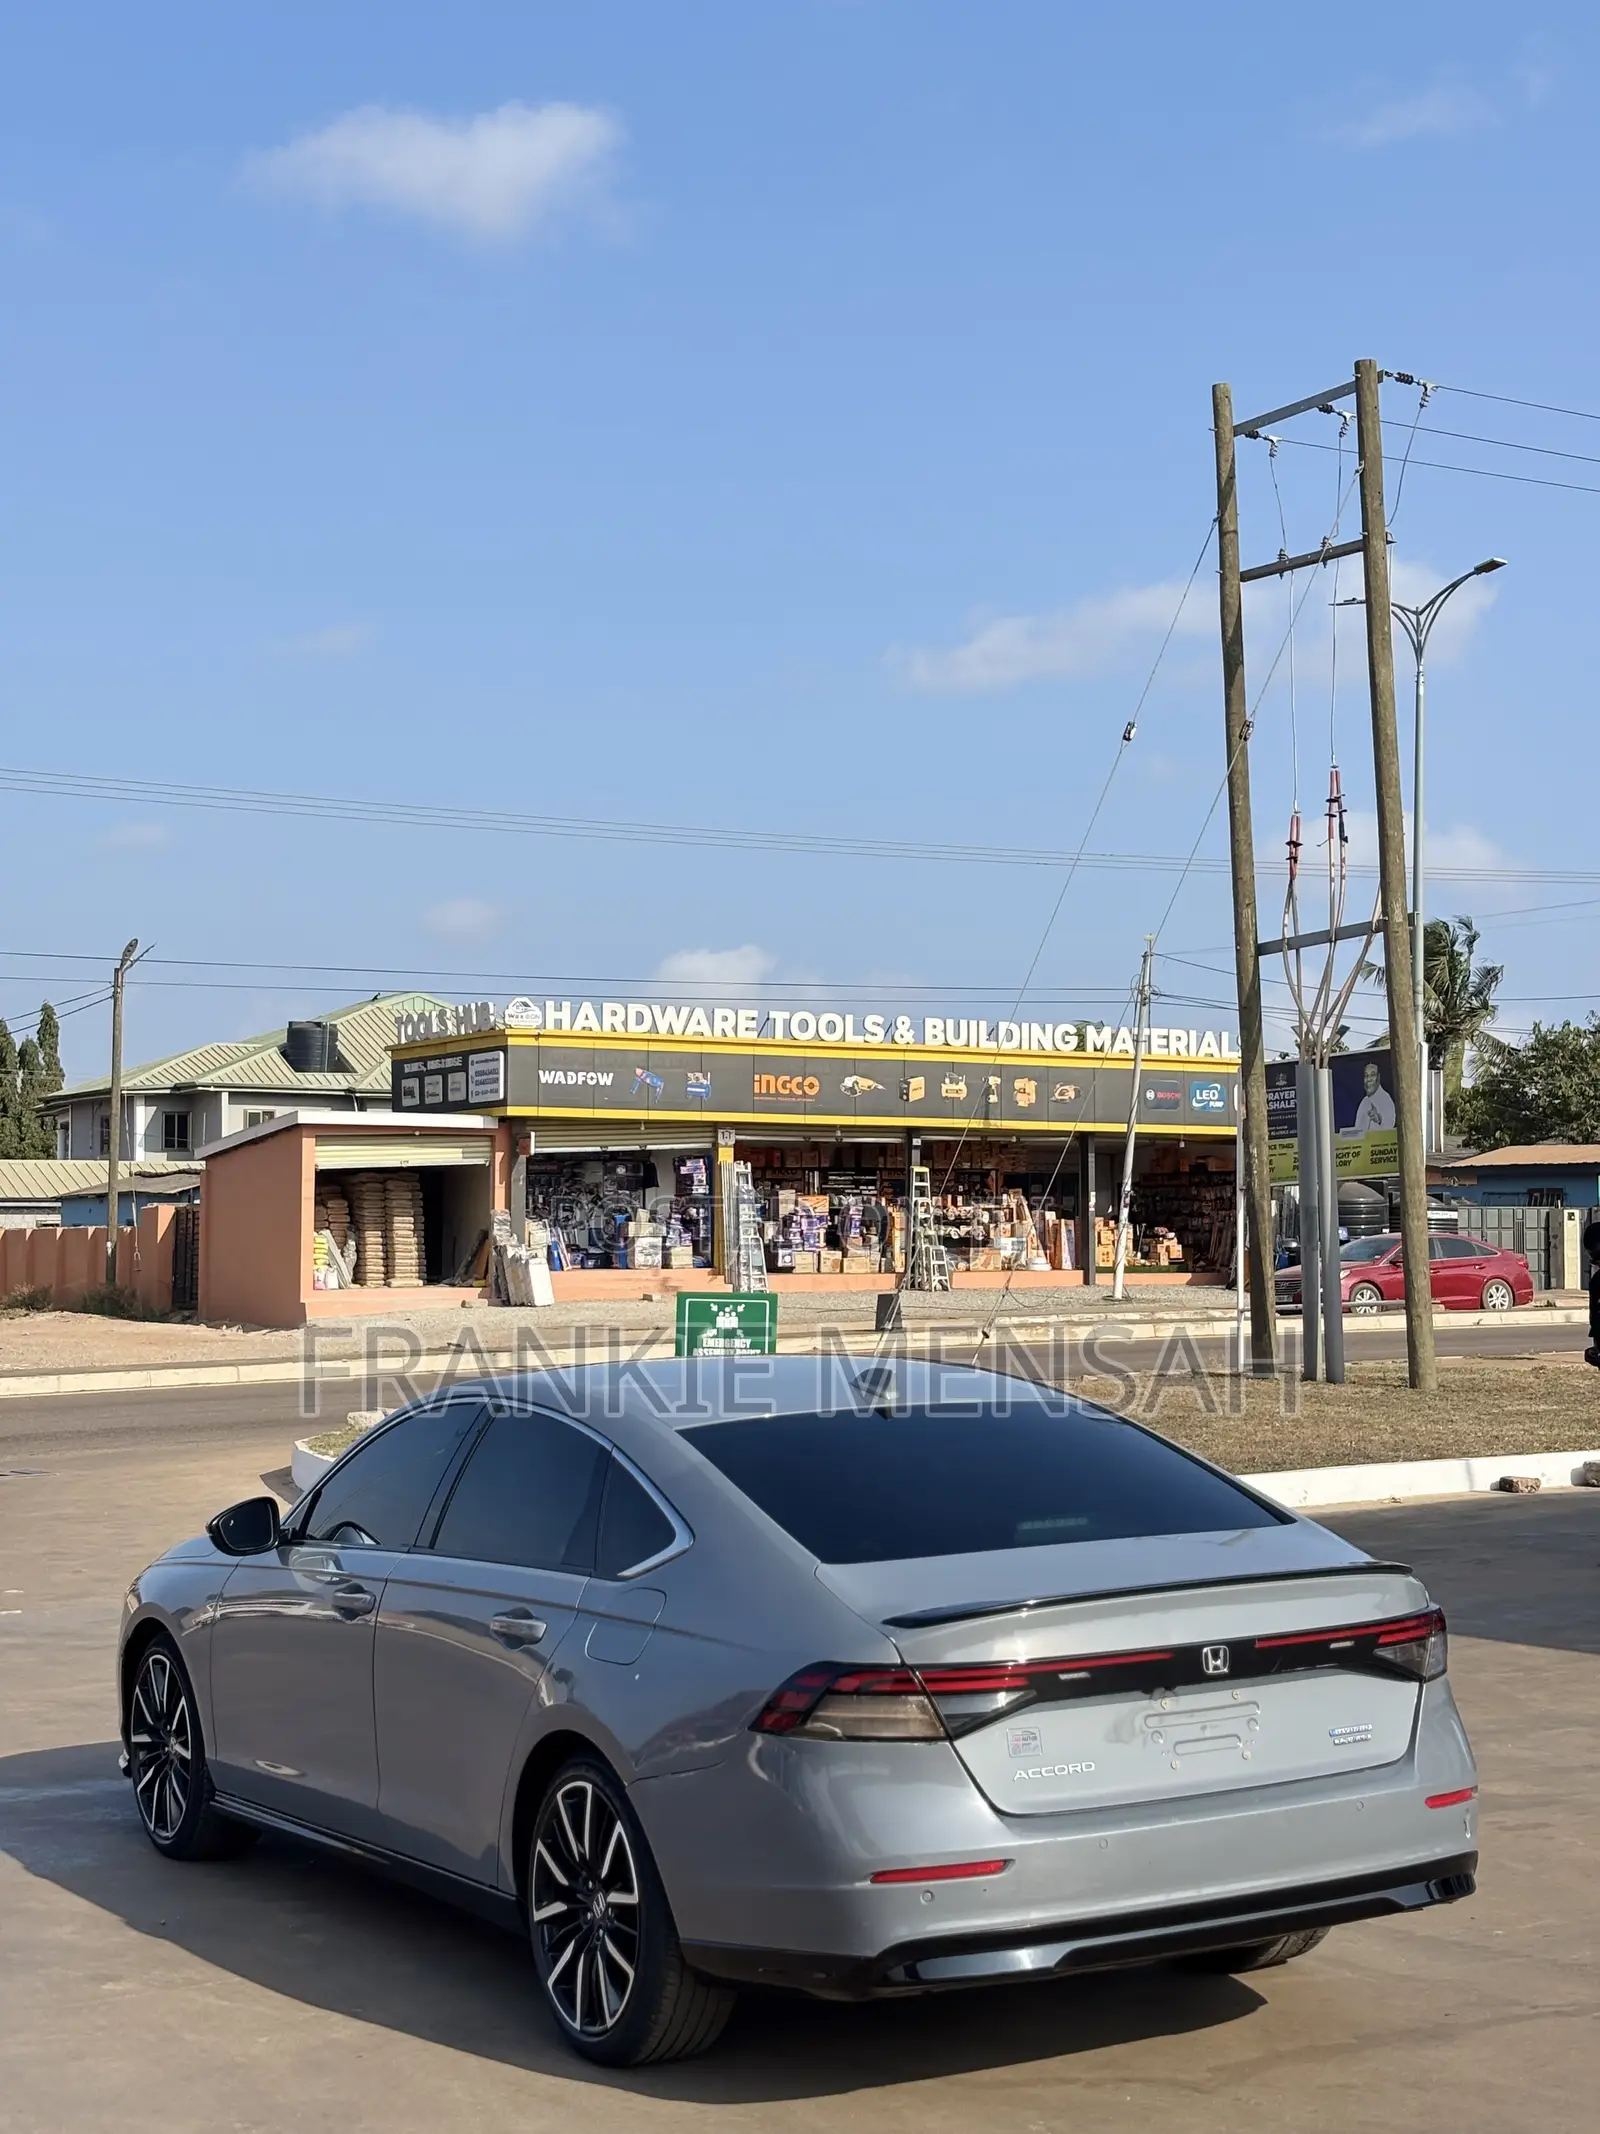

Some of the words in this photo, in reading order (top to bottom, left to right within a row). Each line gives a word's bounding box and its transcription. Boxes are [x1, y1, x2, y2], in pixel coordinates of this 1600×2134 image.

[394, 1009, 451, 1044] TOOLS
[456, 1001, 496, 1035] HUB
[543, 1000, 759, 1038] HARDWARE
[767, 1010, 886, 1044] TOOLS
[892, 1015, 916, 1045] &
[923, 1017, 1079, 1053] BUILDING
[1085, 1024, 1241, 1059] MATERIAL
[538, 1070, 614, 1086] WADFOW
[1156, 1091, 1181, 1099] BOSCH
[1196, 1089, 1219, 1100] LEO
[1266, 1090, 1296, 1101] RAYER
[1335, 1151, 1351, 1160] IGHT
[1352, 1150, 1361, 1158] OF
[1370, 1148, 1397, 1157] SUNDAY
[1335, 1159, 1352, 1167] LORY
[1370, 1156, 1397, 1165] SERVICE
[702, 1338, 752, 1348] EMERGENCY
[1013, 1761, 1096, 1781] ACCORD
